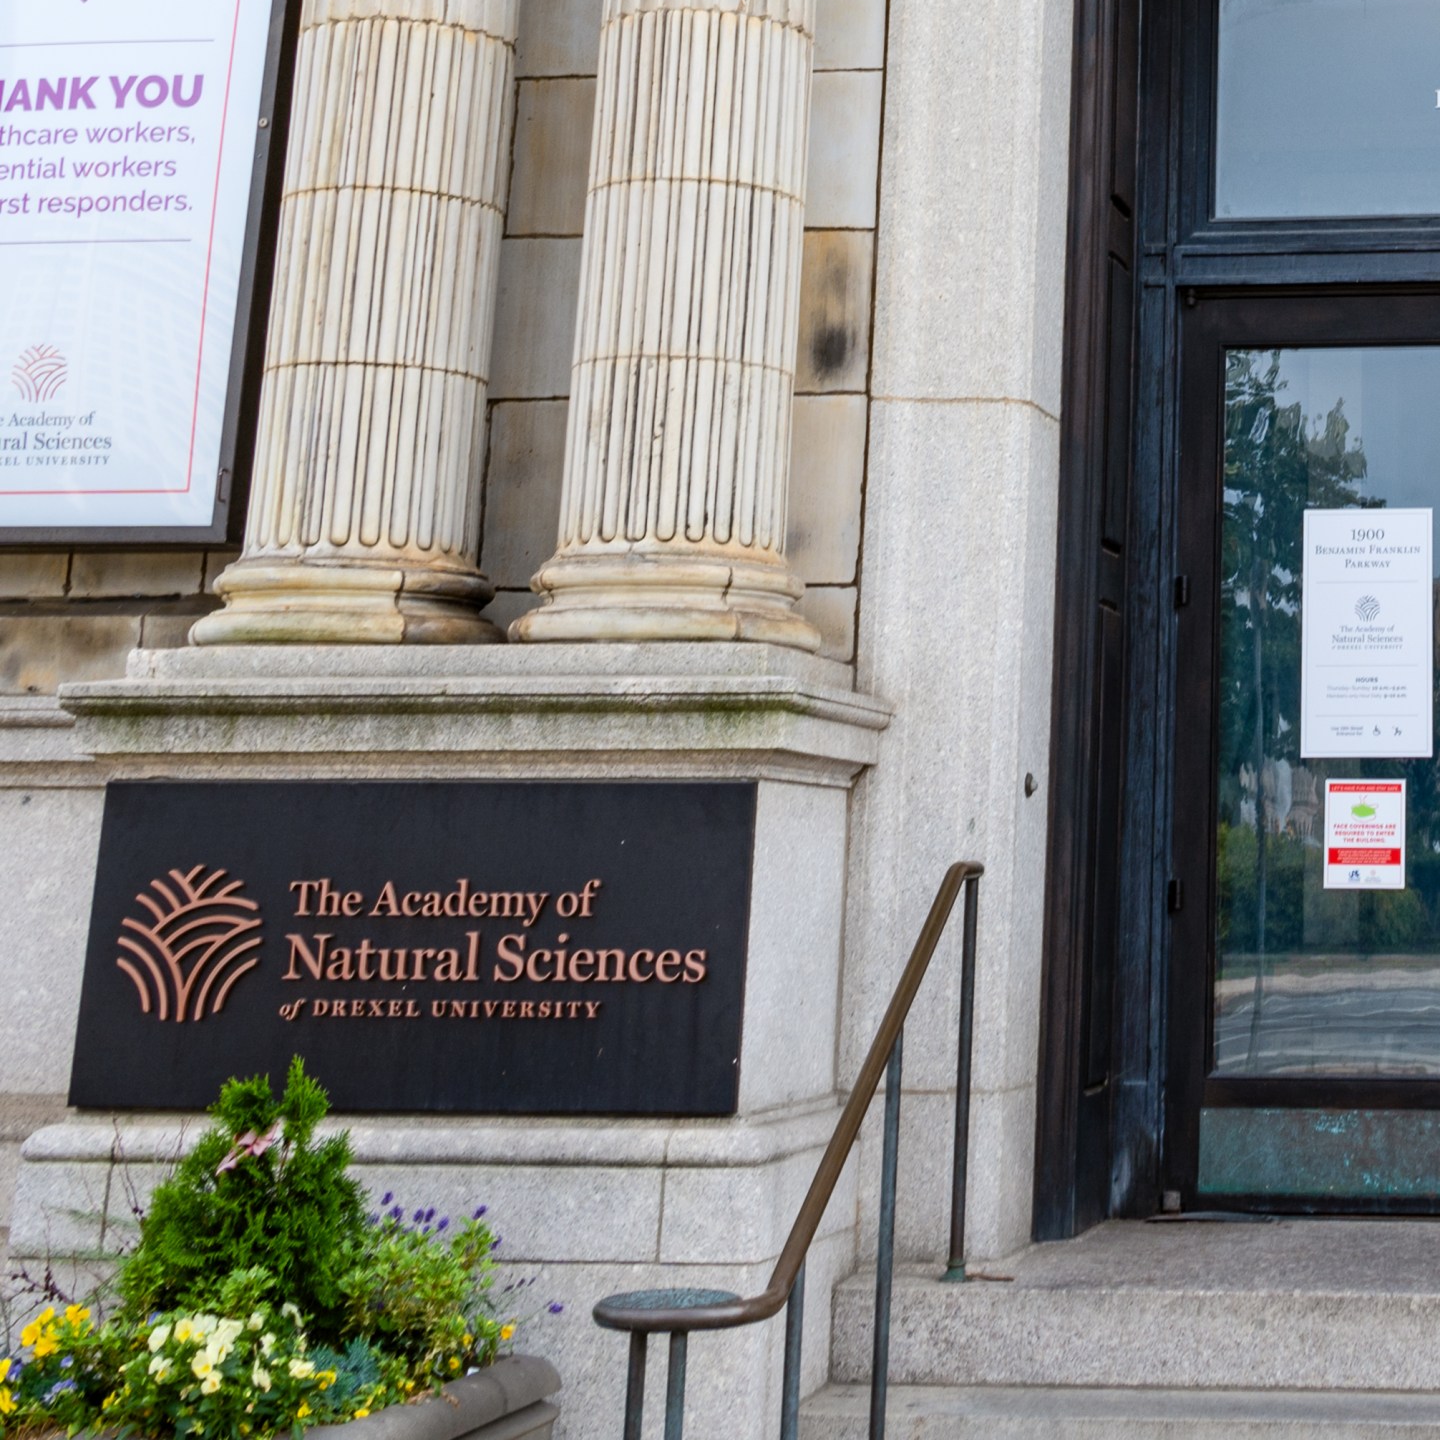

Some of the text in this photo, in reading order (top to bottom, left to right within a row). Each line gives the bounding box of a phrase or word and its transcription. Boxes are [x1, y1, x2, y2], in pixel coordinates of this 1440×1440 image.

[0, 73, 204, 112] ANK YOU
[86, 120, 196, 145] workers,
[73, 155, 177, 178] workers
[37, 189, 193, 218] responders.
[8, 410, 76, 429] Academy
[79, 410, 96, 427] of
[0, 431, 112, 450] ral Sciences
[26, 454, 110, 466] UNIVERSITY
[1351, 528, 1385, 542] 1900
[1332, 634, 1403, 644] Natural Sciences
[1339, 625, 1353, 633] The
[1355, 625, 1386, 634] Academy
[289, 878, 602, 927] The Academy of
[281, 931, 706, 983] Natural Sciences
[278, 998, 602, 1021] of DREXEL UNIVERSITY
